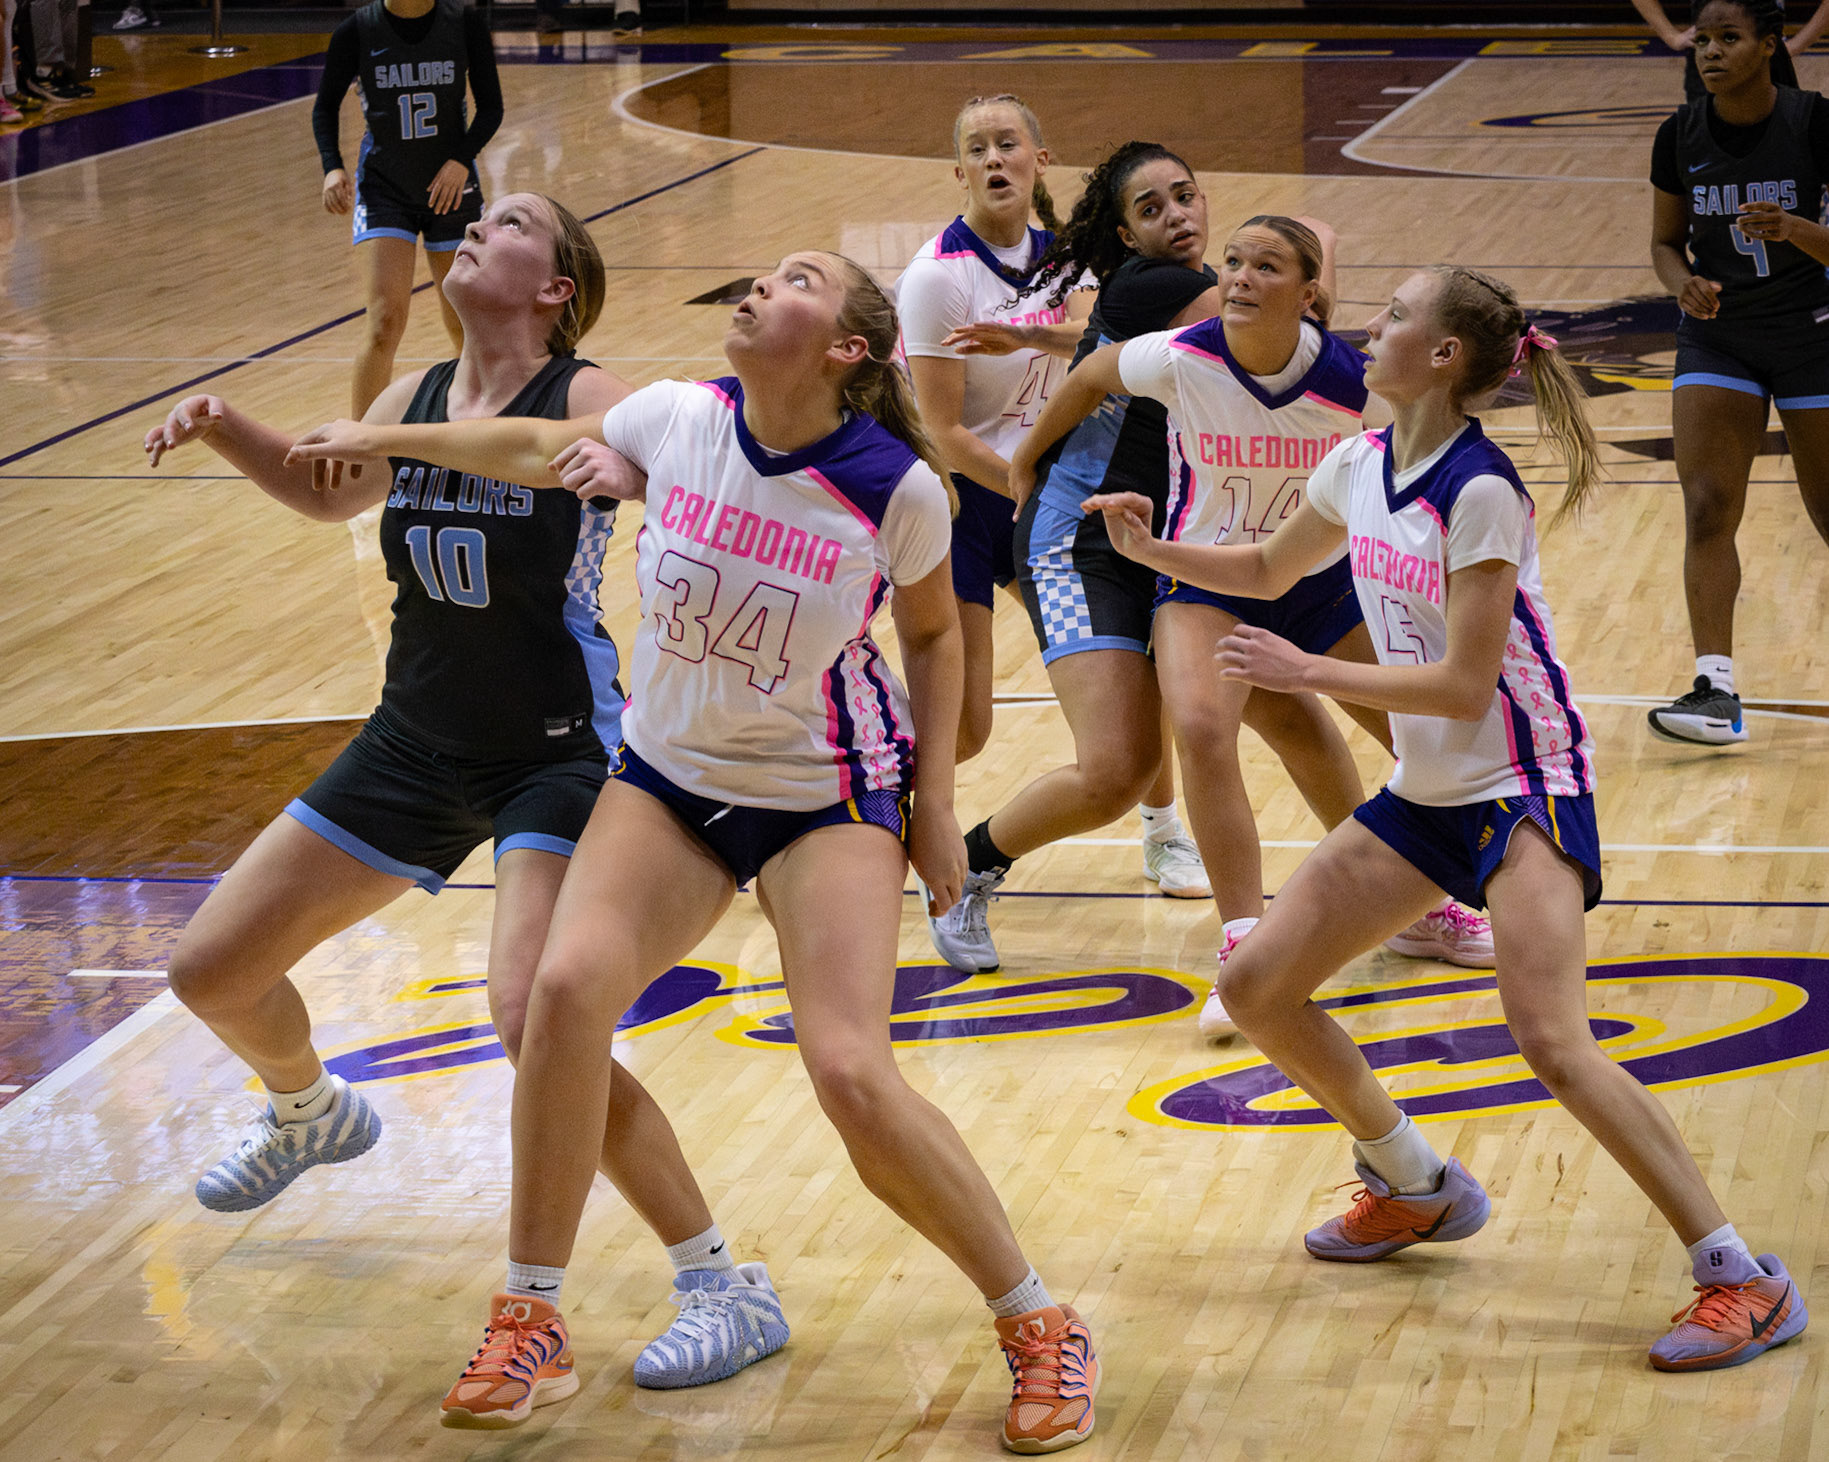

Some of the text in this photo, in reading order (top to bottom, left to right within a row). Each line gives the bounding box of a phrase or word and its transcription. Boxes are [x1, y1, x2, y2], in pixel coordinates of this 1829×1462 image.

[374, 60, 455, 89] SAILORS
[397, 92, 439, 140] 12
[1692, 179, 1798, 216] SAILORS
[386, 466, 534, 517] SAILORS
[660, 484, 844, 585] CALEDONIA
[405, 525, 490, 609] 10
[654, 549, 801, 696] 34
